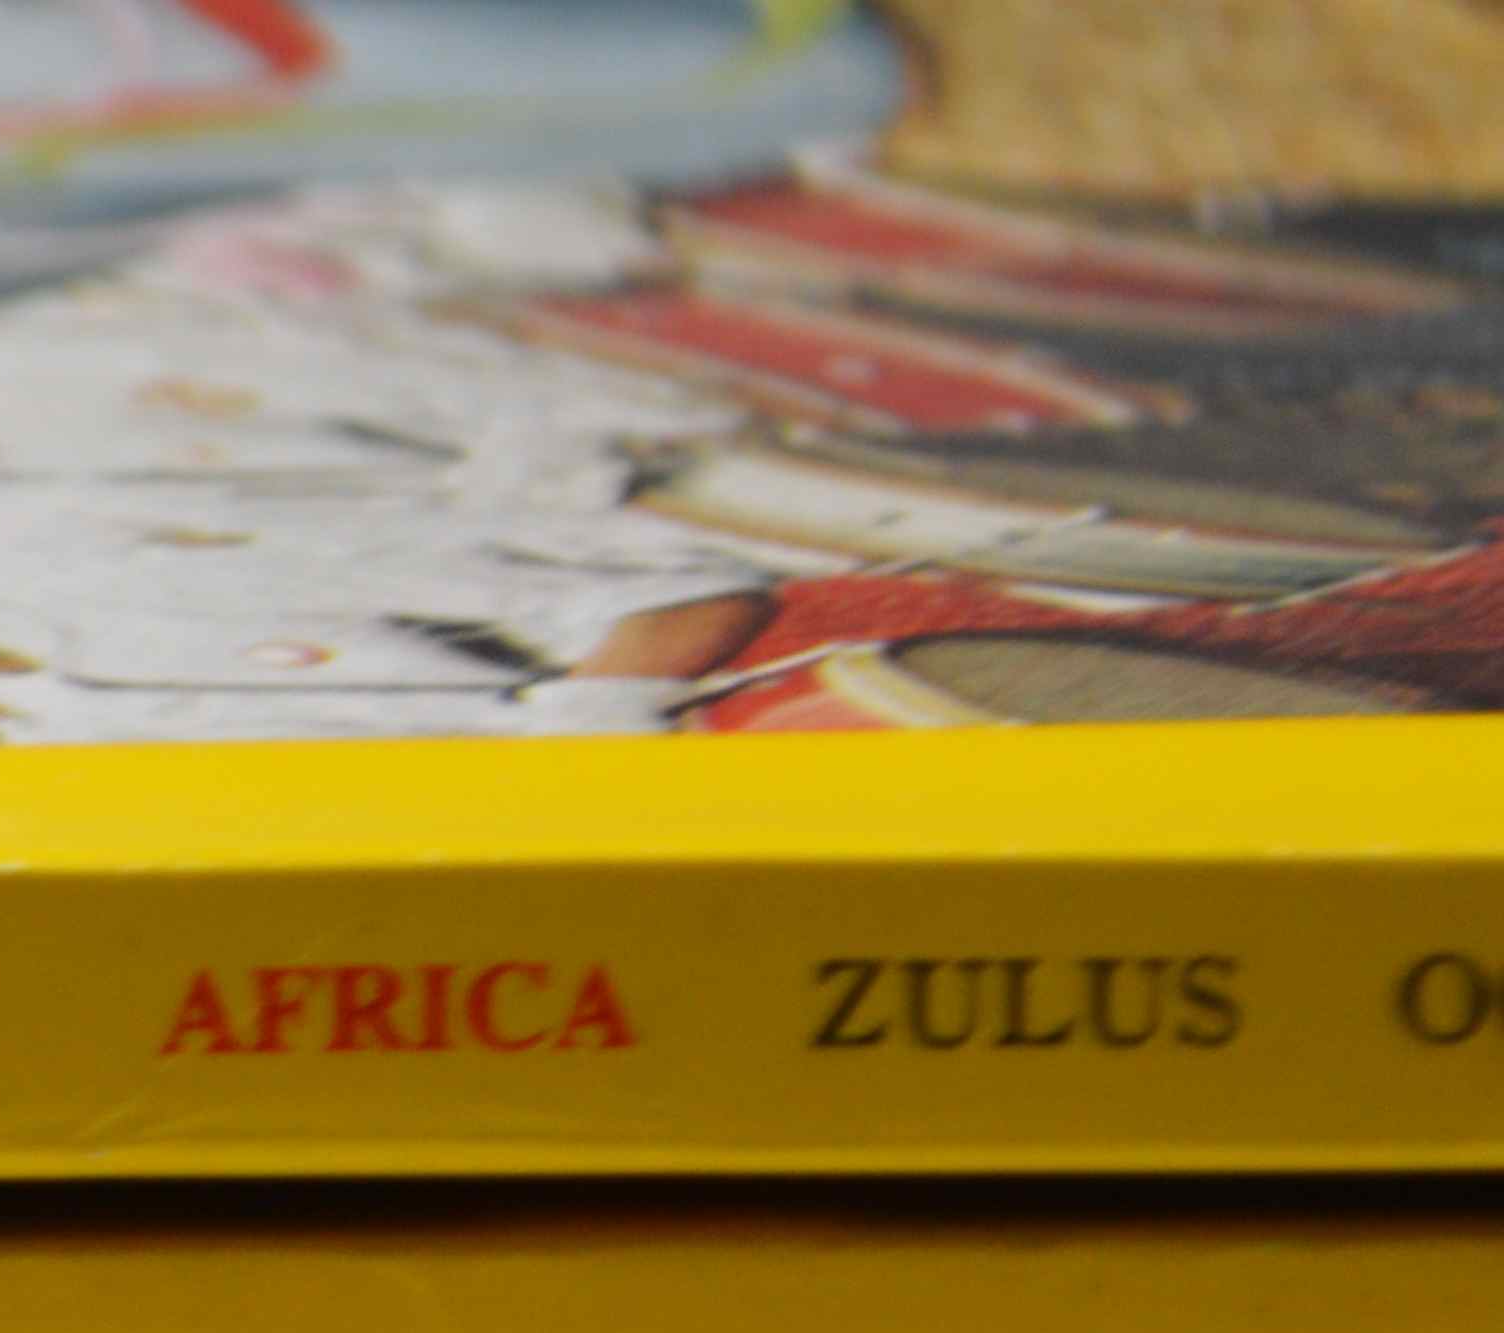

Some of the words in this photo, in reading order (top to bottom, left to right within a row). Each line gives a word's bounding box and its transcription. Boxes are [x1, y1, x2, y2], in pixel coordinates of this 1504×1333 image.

[159, 960, 639, 1056] AFRICA
[808, 954, 1237, 1051] ZULUS
[1394, 952, 1504, 1047] O
